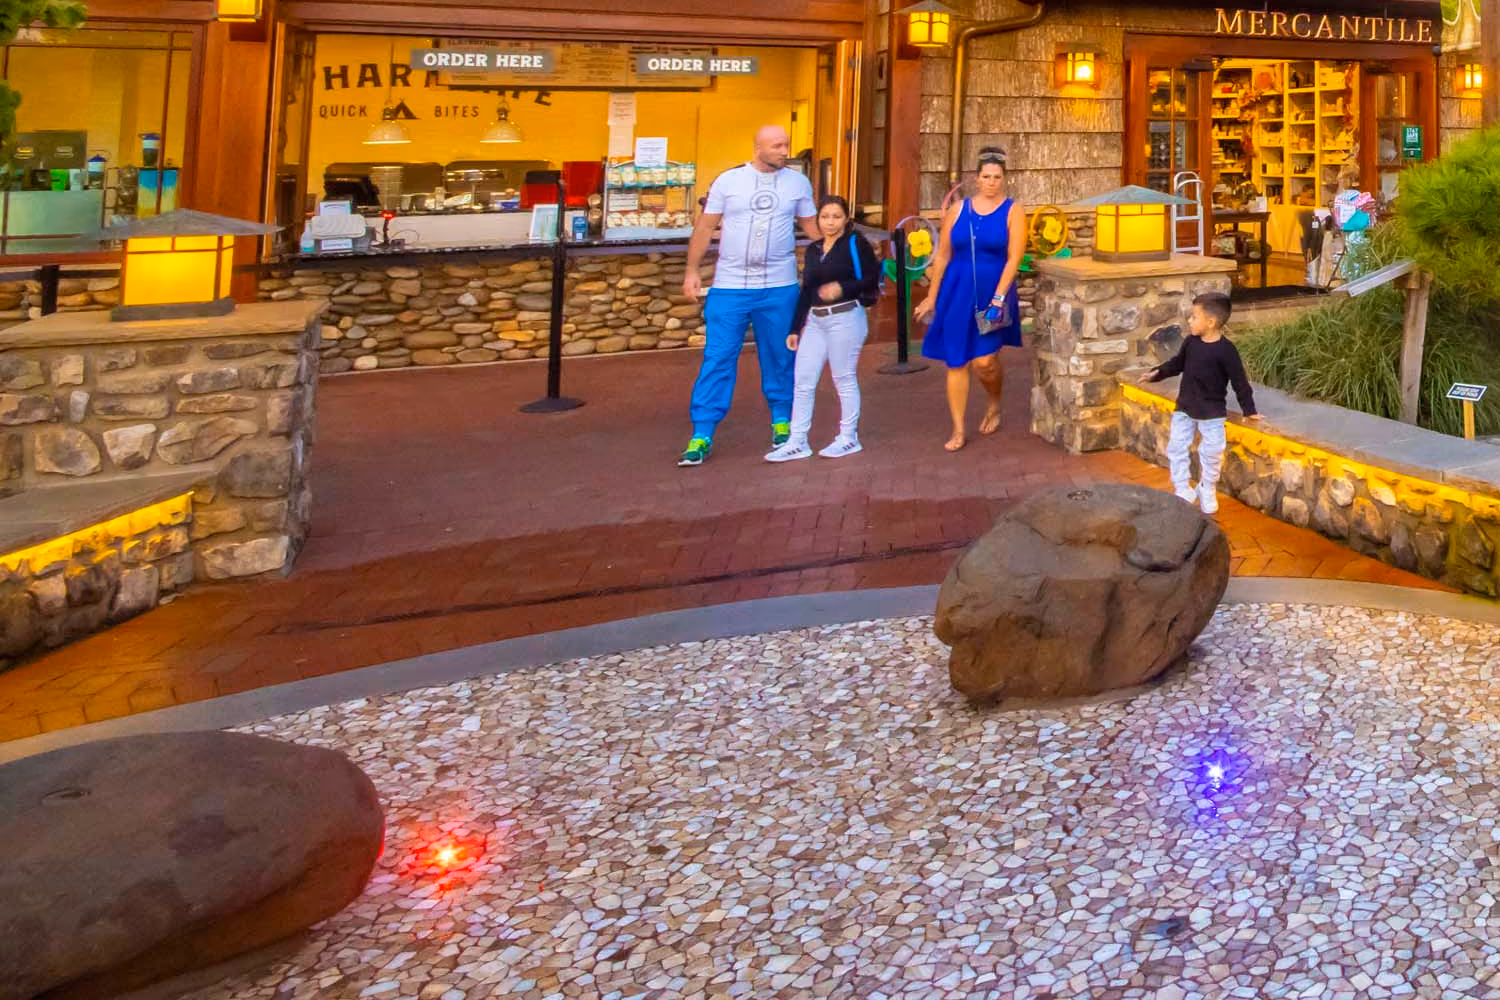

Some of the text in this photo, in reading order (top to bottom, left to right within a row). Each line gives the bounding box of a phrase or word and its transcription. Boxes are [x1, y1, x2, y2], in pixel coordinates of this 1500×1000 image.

[1215, 7, 1433, 43] MERCANTILE
[423, 52, 544, 69] ORDER HERE
[647, 58, 752, 72] ORDER HERE
[319, 104, 480, 119] QUICK BITES
